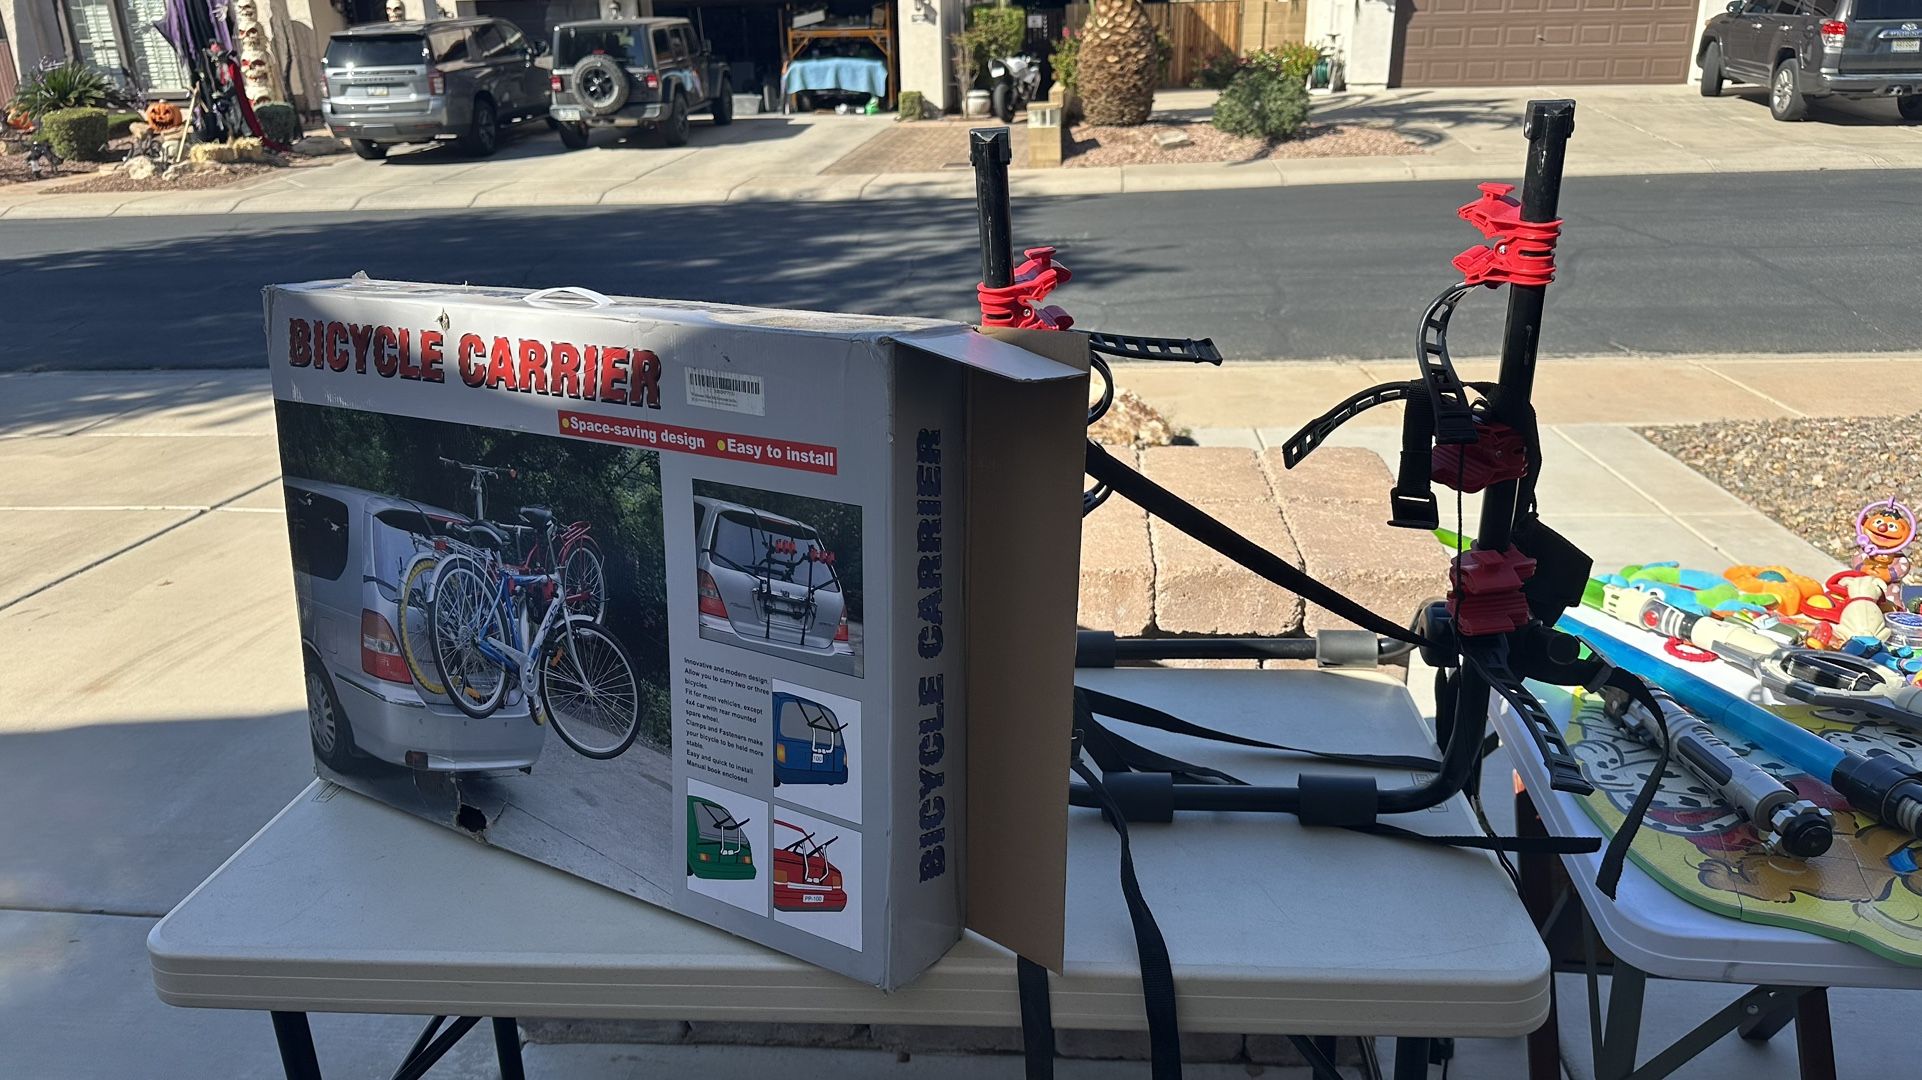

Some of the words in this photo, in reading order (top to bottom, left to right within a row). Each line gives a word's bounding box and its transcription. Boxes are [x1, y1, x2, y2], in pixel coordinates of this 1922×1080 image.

[289, 318, 445, 383] BICYCLE
[458, 332, 662, 409] CARRIER
[570, 416, 657, 443] Space-saving
[661, 429, 705, 450] design
[727, 438, 762, 460] Easy
[766, 444, 782, 459] to
[786, 446, 834, 467] install
[917, 428, 943, 660] CARRIER
[684, 657, 712, 670] Innovative
[713, 665, 724, 673] and
[725, 668, 747, 678] modern
[684, 667, 700, 677] Allow
[720, 678, 734, 687] carry
[735, 681, 746, 689] two
[754, 686, 770, 696] three
[686, 698, 695, 706] 4x4
[706, 704, 718, 713] with
[719, 708, 730, 716] rear
[731, 712, 757, 723] mounted
[686, 709, 701, 718] spare
[702, 693, 717, 702] most
[743, 705, 763, 715] except
[686, 718, 706, 730] Clamps
[707, 725, 718, 733] and
[719, 728, 747, 741] Fasteners
[748, 737, 763, 746] make
[700, 733, 719, 743] bicycle
[727, 741, 734, 749] be
[735, 743, 748, 752] held
[749, 748, 764, 757] more
[686, 749, 700, 759] Easy
[701, 753, 711, 761] and
[712, 758, 728, 767] quick
[686, 759, 706, 770] Manual
[707, 765, 721, 775] book
[919, 673, 946, 884] BICYCLE
